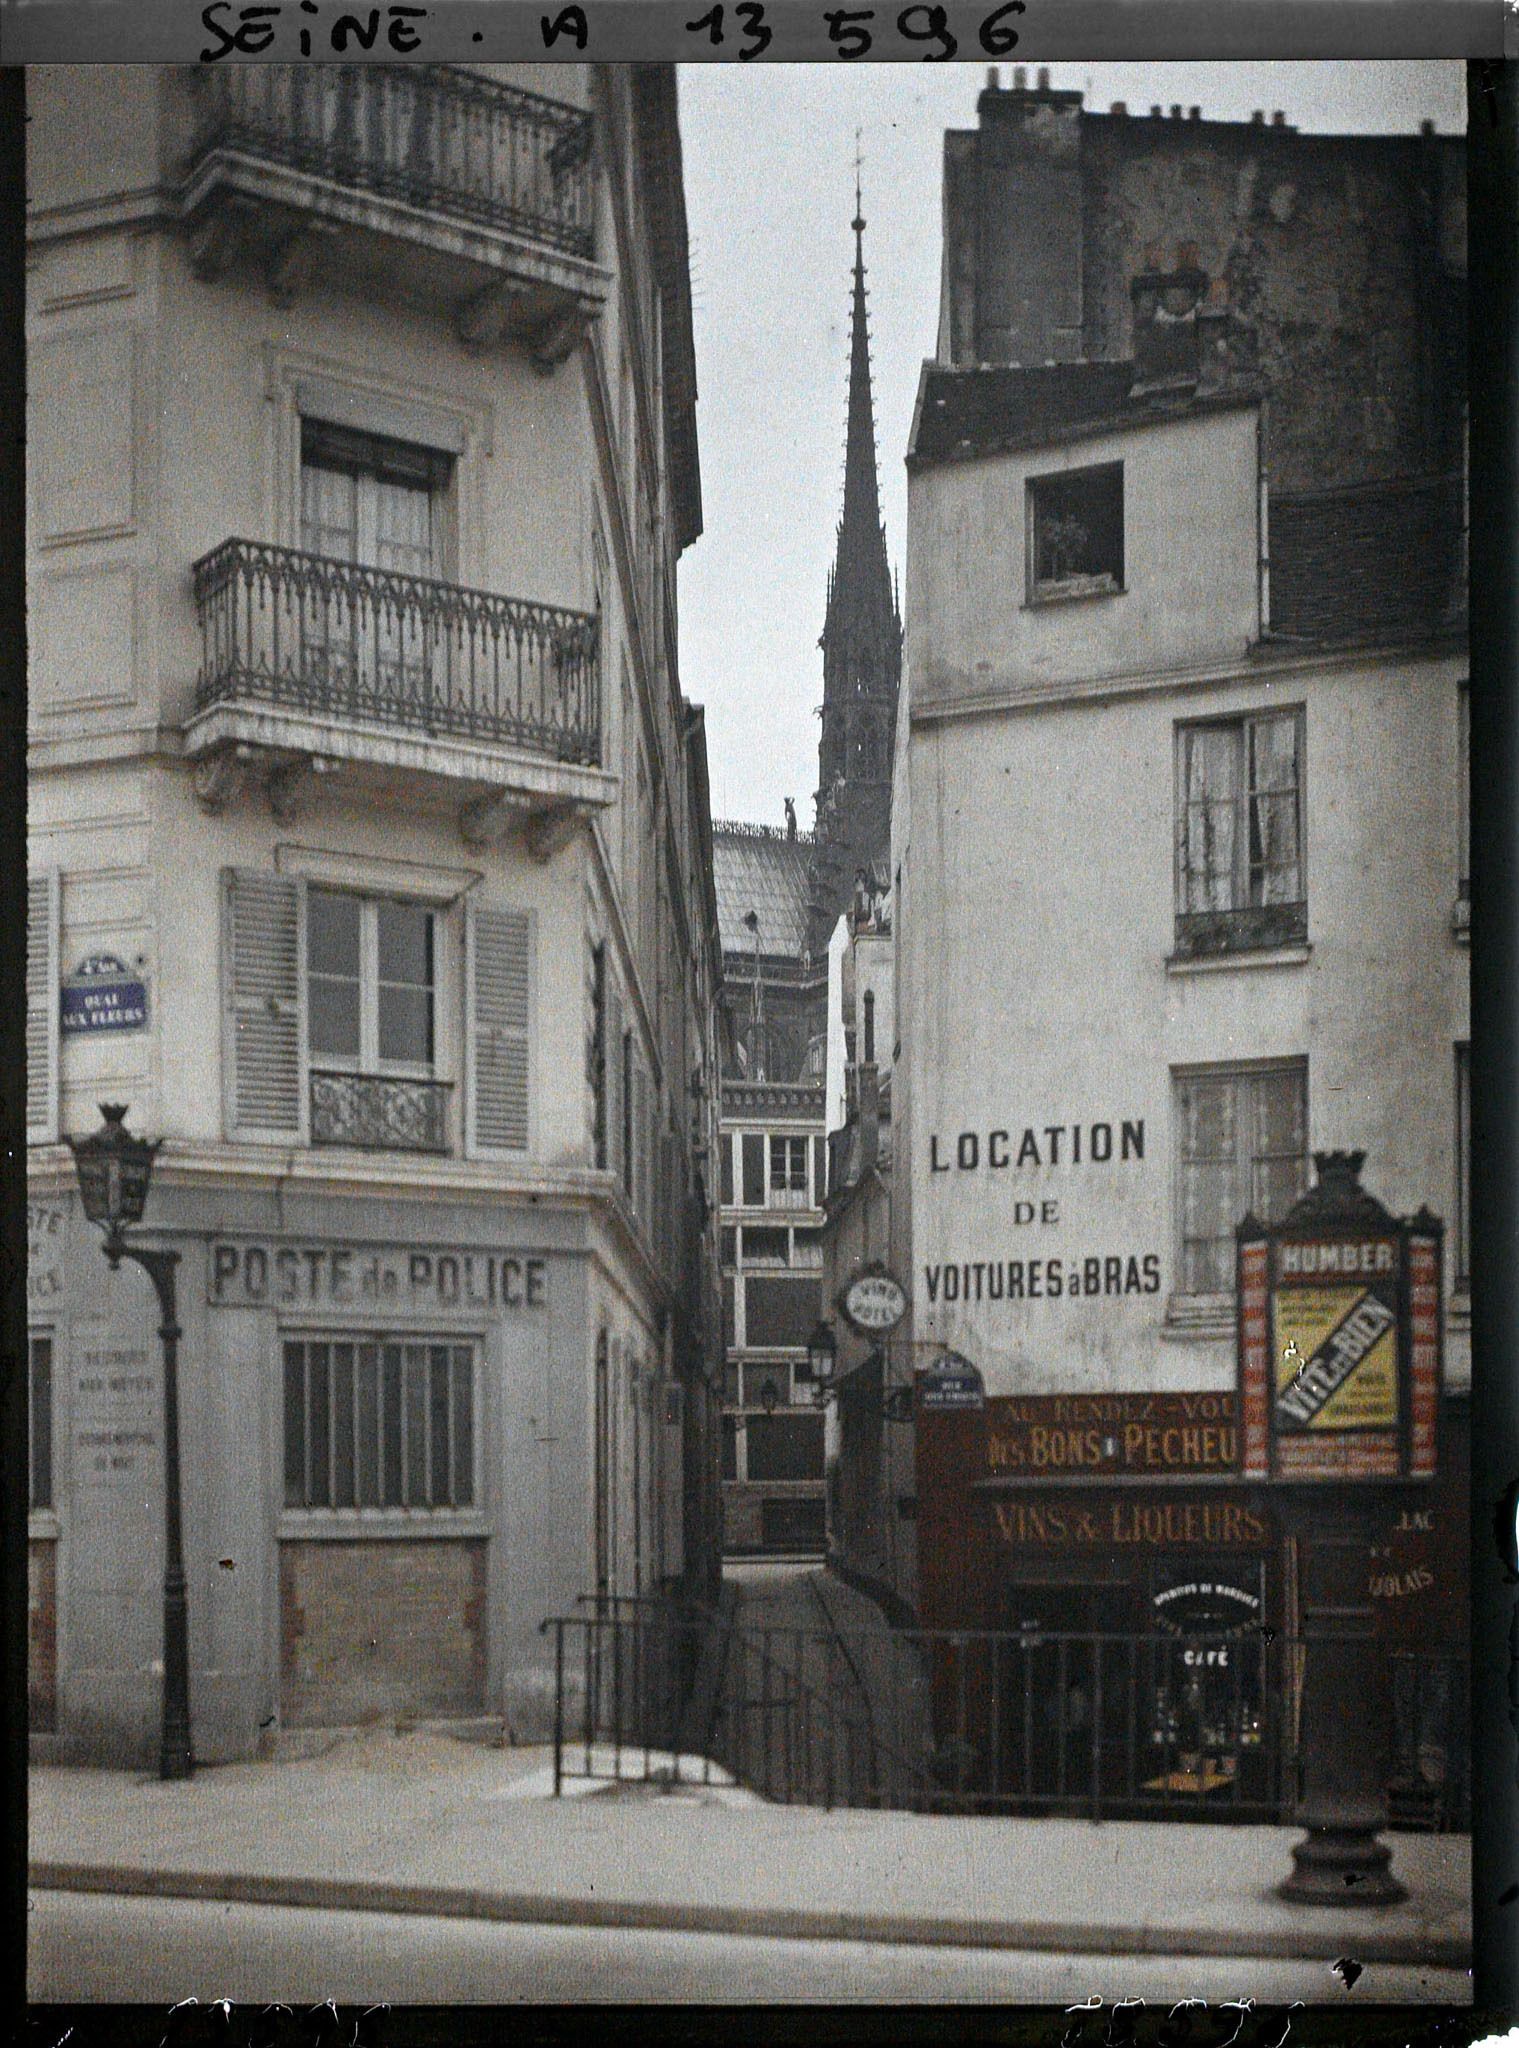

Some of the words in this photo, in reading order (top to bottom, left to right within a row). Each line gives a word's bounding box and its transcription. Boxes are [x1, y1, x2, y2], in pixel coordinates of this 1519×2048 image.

[84, 992, 119, 1009] QUAI
[930, 1119, 1146, 1173] LOCATION
[1014, 1200, 1060, 1225] DE
[213, 1246, 350, 1301] POSTE
[363, 1257, 397, 1298] de
[410, 1255, 546, 1306] POLICE
[925, 1259, 1063, 1303] VOITURES
[1084, 1253, 1161, 1297] BRAS
[1283, 1241, 1394, 1273] HUMBER
[1276, 1356, 1342, 1422] VITE
[1331, 1296, 1396, 1359] BIEN
[1030, 1424, 1101, 1467] BONS
[995, 1502, 1067, 1542] VINS
[1112, 1501, 1265, 1544] LIQUEURS
